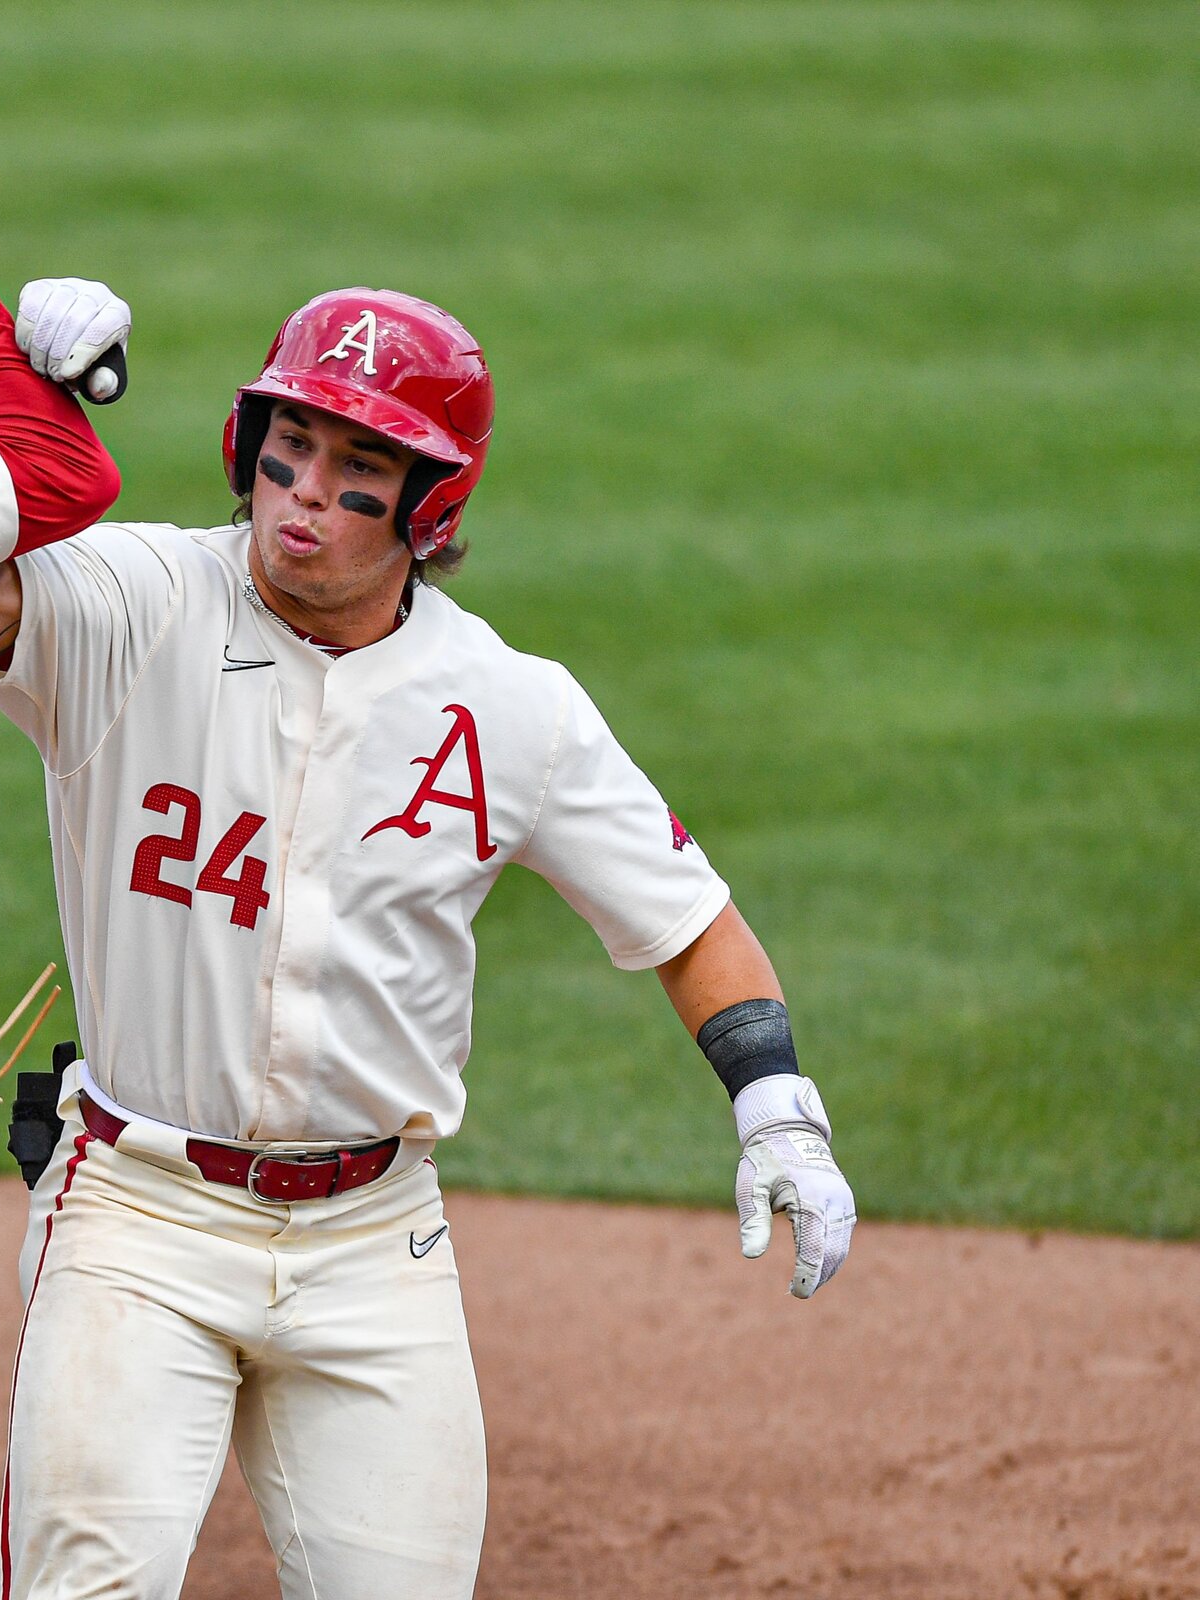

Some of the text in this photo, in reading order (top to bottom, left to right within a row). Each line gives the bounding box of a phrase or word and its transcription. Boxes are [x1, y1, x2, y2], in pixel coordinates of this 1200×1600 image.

[317, 309, 378, 377] A
[128, 782, 271, 932] 24
[360, 702, 499, 862] A
